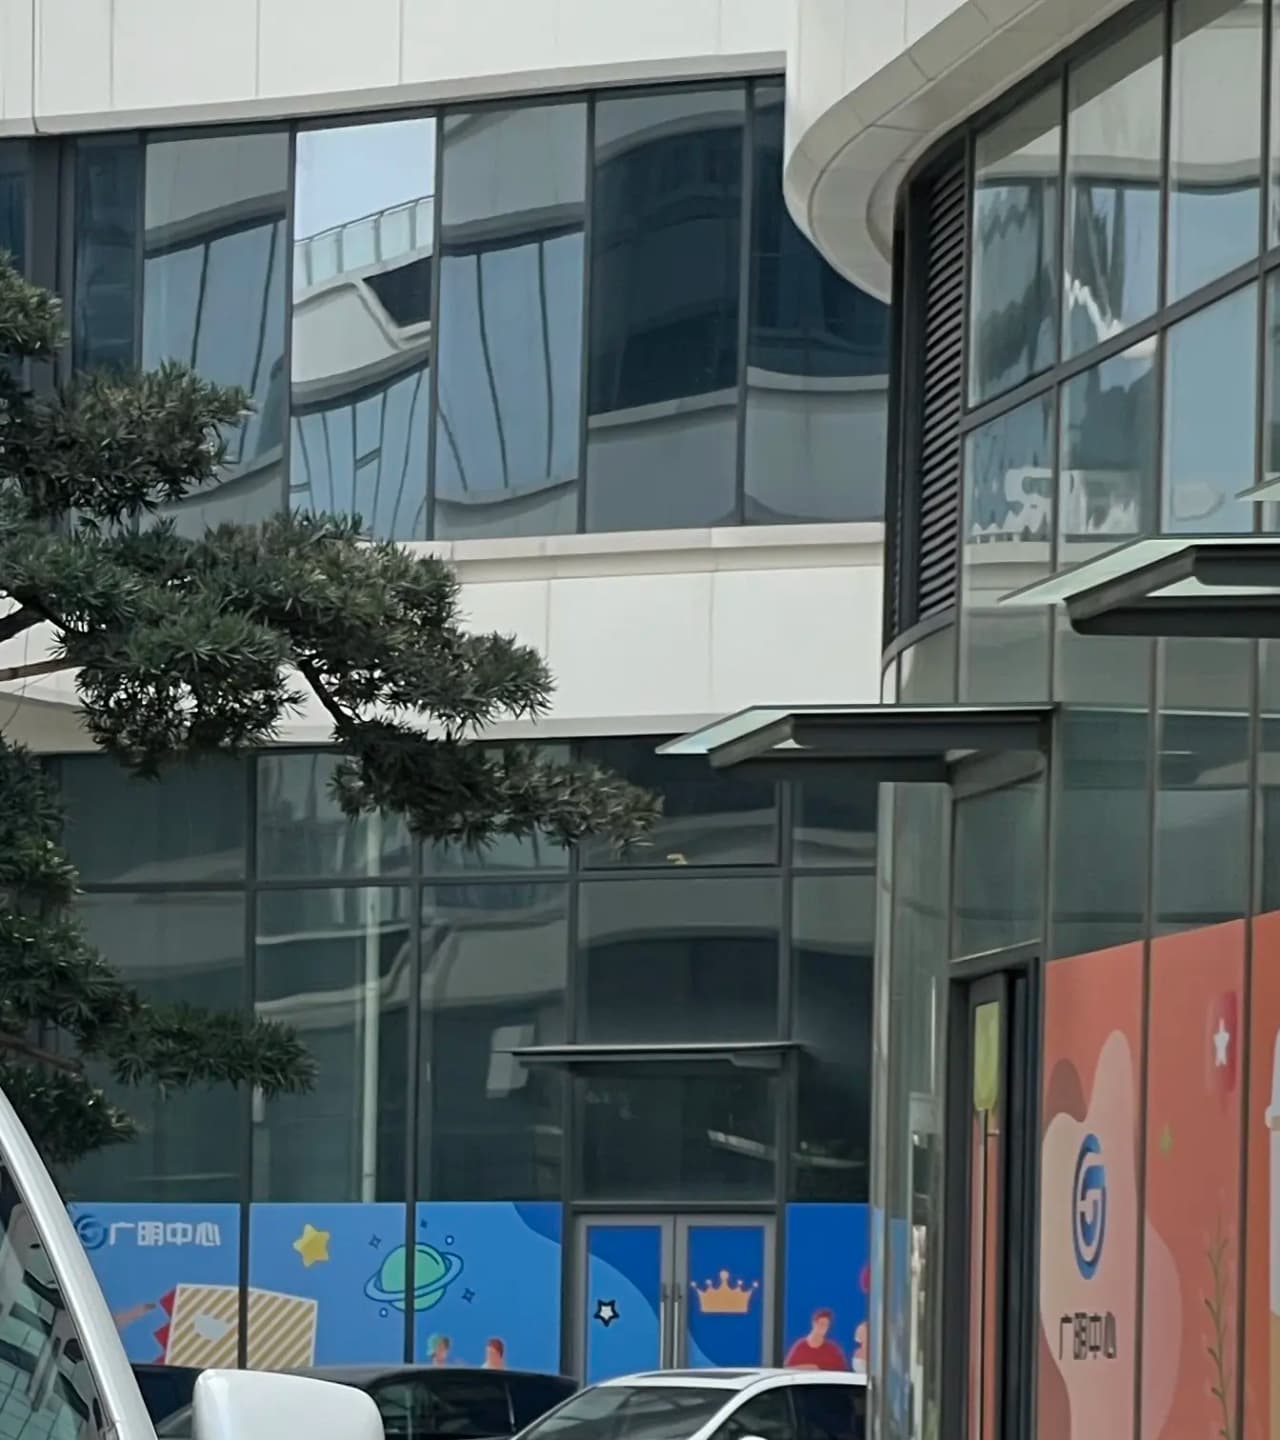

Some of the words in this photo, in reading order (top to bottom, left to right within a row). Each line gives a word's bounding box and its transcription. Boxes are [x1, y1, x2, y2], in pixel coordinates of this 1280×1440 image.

[109, 1221, 221, 1247] 广明中心
[1059, 1310, 1117, 1360] 广明中心
